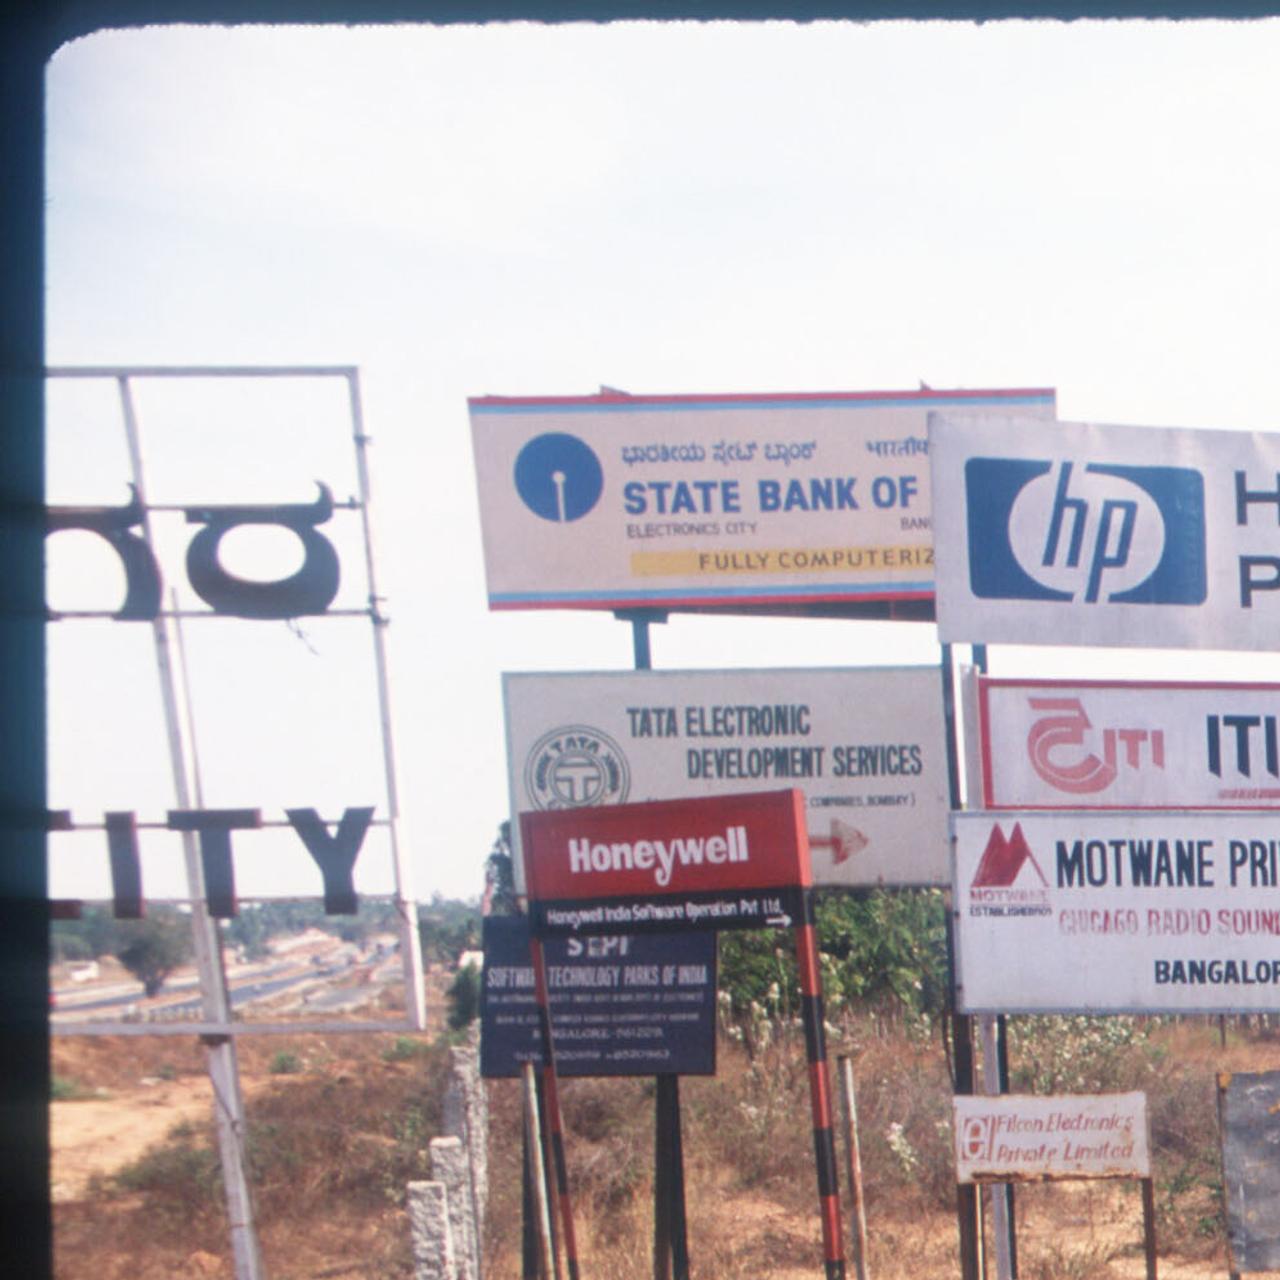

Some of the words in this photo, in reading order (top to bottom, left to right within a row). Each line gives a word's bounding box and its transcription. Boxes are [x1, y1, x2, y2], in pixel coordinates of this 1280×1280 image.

[623, 480, 742, 515] STATE
[758, 476, 859, 512] BANK
[871, 475, 918, 509] OF
[626, 522, 720, 539] ELECTRONICS
[726, 521, 757, 535] CITY
[699, 552, 770, 571] FULLY
[626, 707, 679, 738] TATA
[684, 705, 811, 738] ELECTRONIC
[1206, 714, 1280, 779] ITI
[687, 747, 825, 779] DEVELOPMENT
[833, 745, 922, 777] SERVICES
[568, 826, 749, 886] Honeywell
[1056, 840, 1215, 888] MOTWANE
[547, 907, 603, 929] Honeywell
[632, 904, 684, 921] Software
[1059, 908, 1139, 935] CHICAGO
[1146, 908, 1212, 936] RADIO
[549, 966, 620, 987] TECHNOLOGY
[624, 965, 658, 986] PARKS
[662, 965, 676, 984] OF
[1063, 1141, 1135, 1162] Limited
